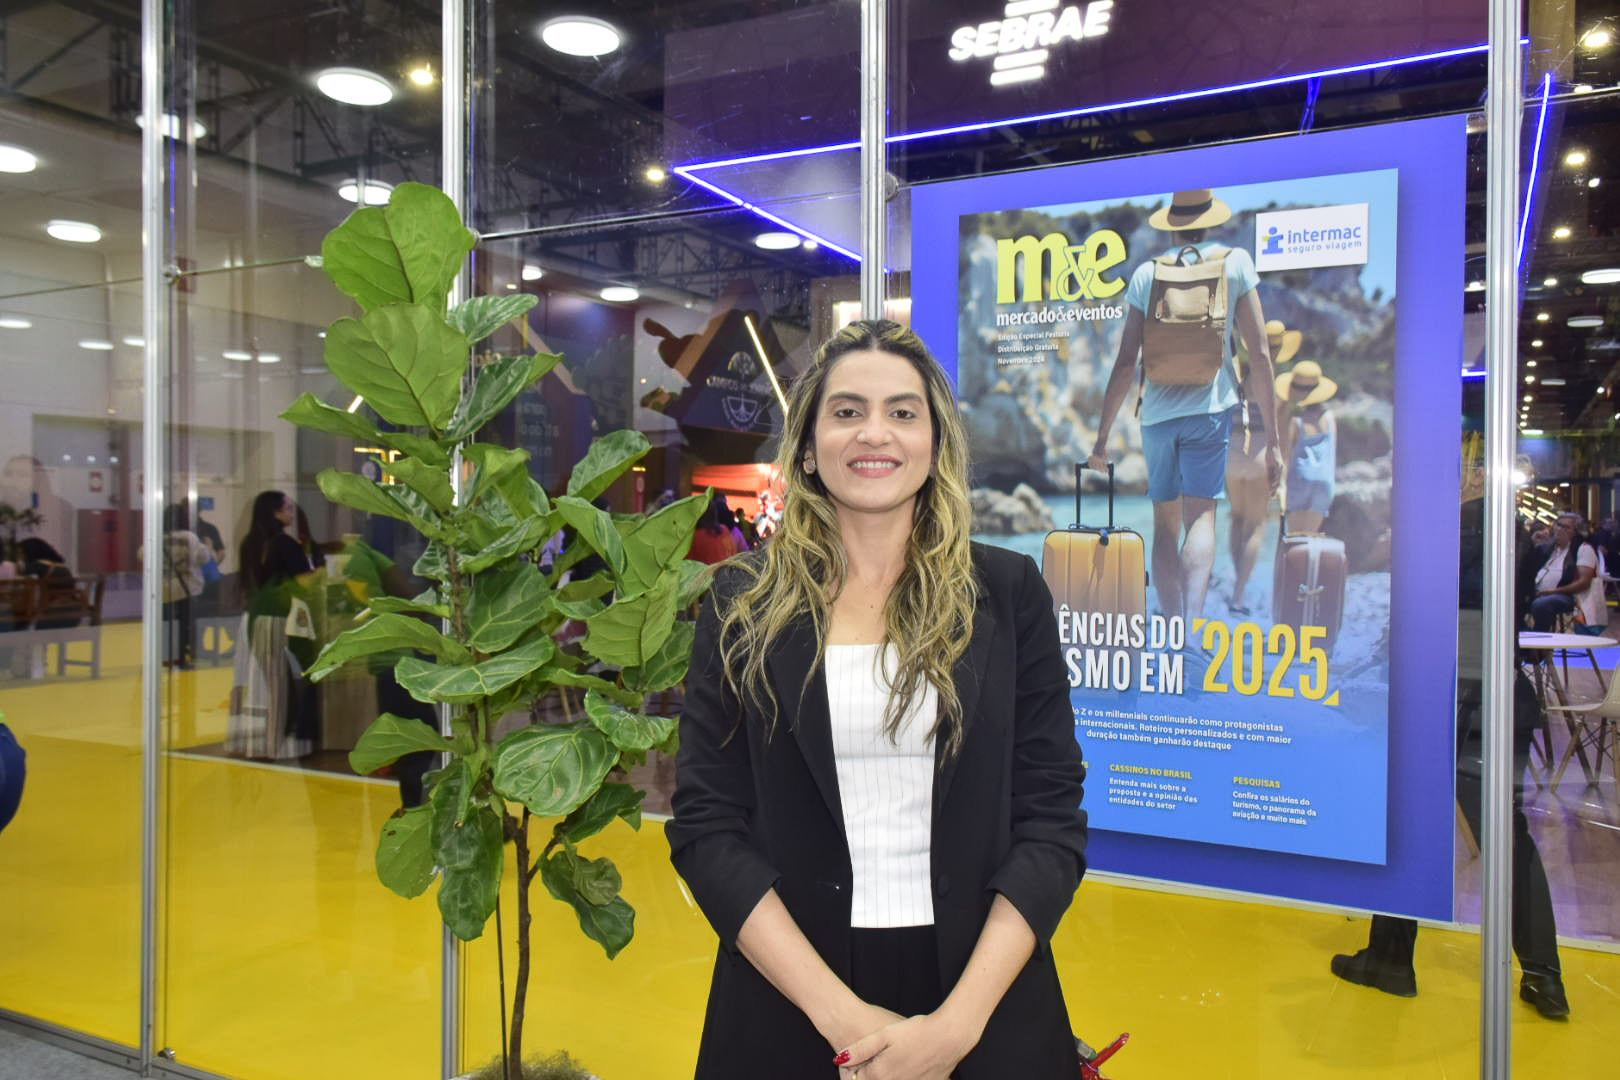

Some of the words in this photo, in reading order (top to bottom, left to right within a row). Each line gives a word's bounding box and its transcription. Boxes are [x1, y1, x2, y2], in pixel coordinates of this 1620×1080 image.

[949, 0, 1114, 61] SEBRAE
[1287, 226, 1361, 244] intermac
[1287, 244, 1322, 254] seguro
[1326, 241, 1362, 250] viagem
[996, 229, 1127, 304] m&e
[996, 304, 1123, 327] mercado&eventos
[1058, 603, 1145, 649] ÊNCIAS
[1150, 614, 1185, 651] DO
[1202, 620, 1329, 701] 2025
[1065, 647, 1131, 691] SMO
[1140, 651, 1184, 695] EM
[1081, 707, 1087, 716] Z
[1094, 709, 1104, 717] os
[1105, 709, 1148, 721] millennials
[1149, 714, 1199, 725] continuarão
[1199, 718, 1223, 727] como
[1224, 720, 1285, 733] protagonistas
[1086, 729, 1118, 741] duração
[1119, 732, 1152, 743] também
[1153, 736, 1192, 749] ganharão
[1193, 738, 1233, 751] destaque
[1139, 722, 1173, 735] Roteiros
[1174, 726, 1238, 740] personalizados
[1246, 733, 1265, 742] com
[1266, 735, 1292, 744] maior
[1109, 764, 1149, 775] CASSINOS
[1150, 768, 1162, 776] NO
[1163, 769, 1193, 779] BRASIL
[1109, 777, 1139, 788] Entenda
[1140, 780, 1158, 790] mais
[1159, 782, 1180, 792] sobre
[1109, 787, 1141, 797] proposta
[1155, 791, 1183, 802] opinião
[1184, 794, 1198, 803] das
[1109, 797, 1144, 807] entidades
[1145, 800, 1156, 808] do
[1157, 802, 1177, 810] setor
[1232, 791, 1259, 801] Confira
[1269, 795, 1299, 805] salários
[1299, 798, 1311, 806] do
[1232, 810, 1260, 822] aviação
[1266, 815, 1288, 824] muito
[1288, 816, 1308, 826] mais
[1269, 805, 1306, 816] panorama
[1306, 808, 1318, 817] da
